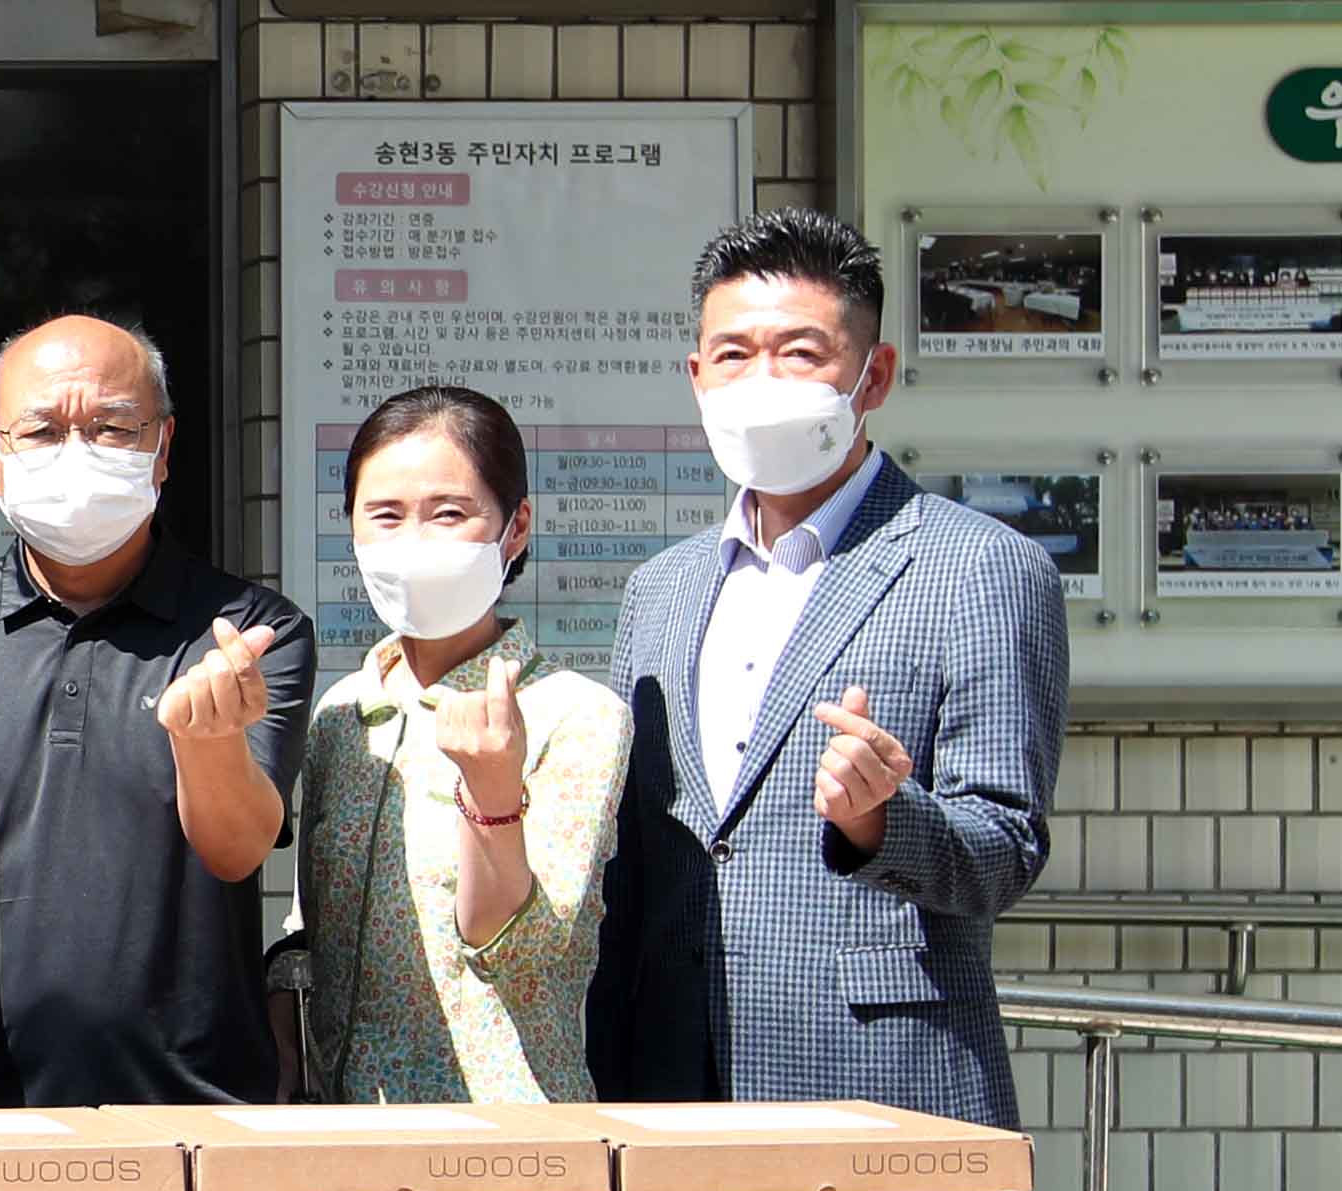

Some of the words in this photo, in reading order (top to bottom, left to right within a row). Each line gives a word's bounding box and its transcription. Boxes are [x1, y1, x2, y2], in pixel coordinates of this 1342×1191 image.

[374, 141, 457, 166] 송현3동
[467, 141, 558, 167] 주민자치
[569, 143, 661, 167] 프로그램
[352, 183, 415, 200] 수강신청
[421, 183, 454, 200] 안내
[342, 228, 395, 244] 접수기간
[2, 1154, 141, 1182] woods
[428, 1152, 566, 1178] woods
[852, 1149, 988, 1175] woods
